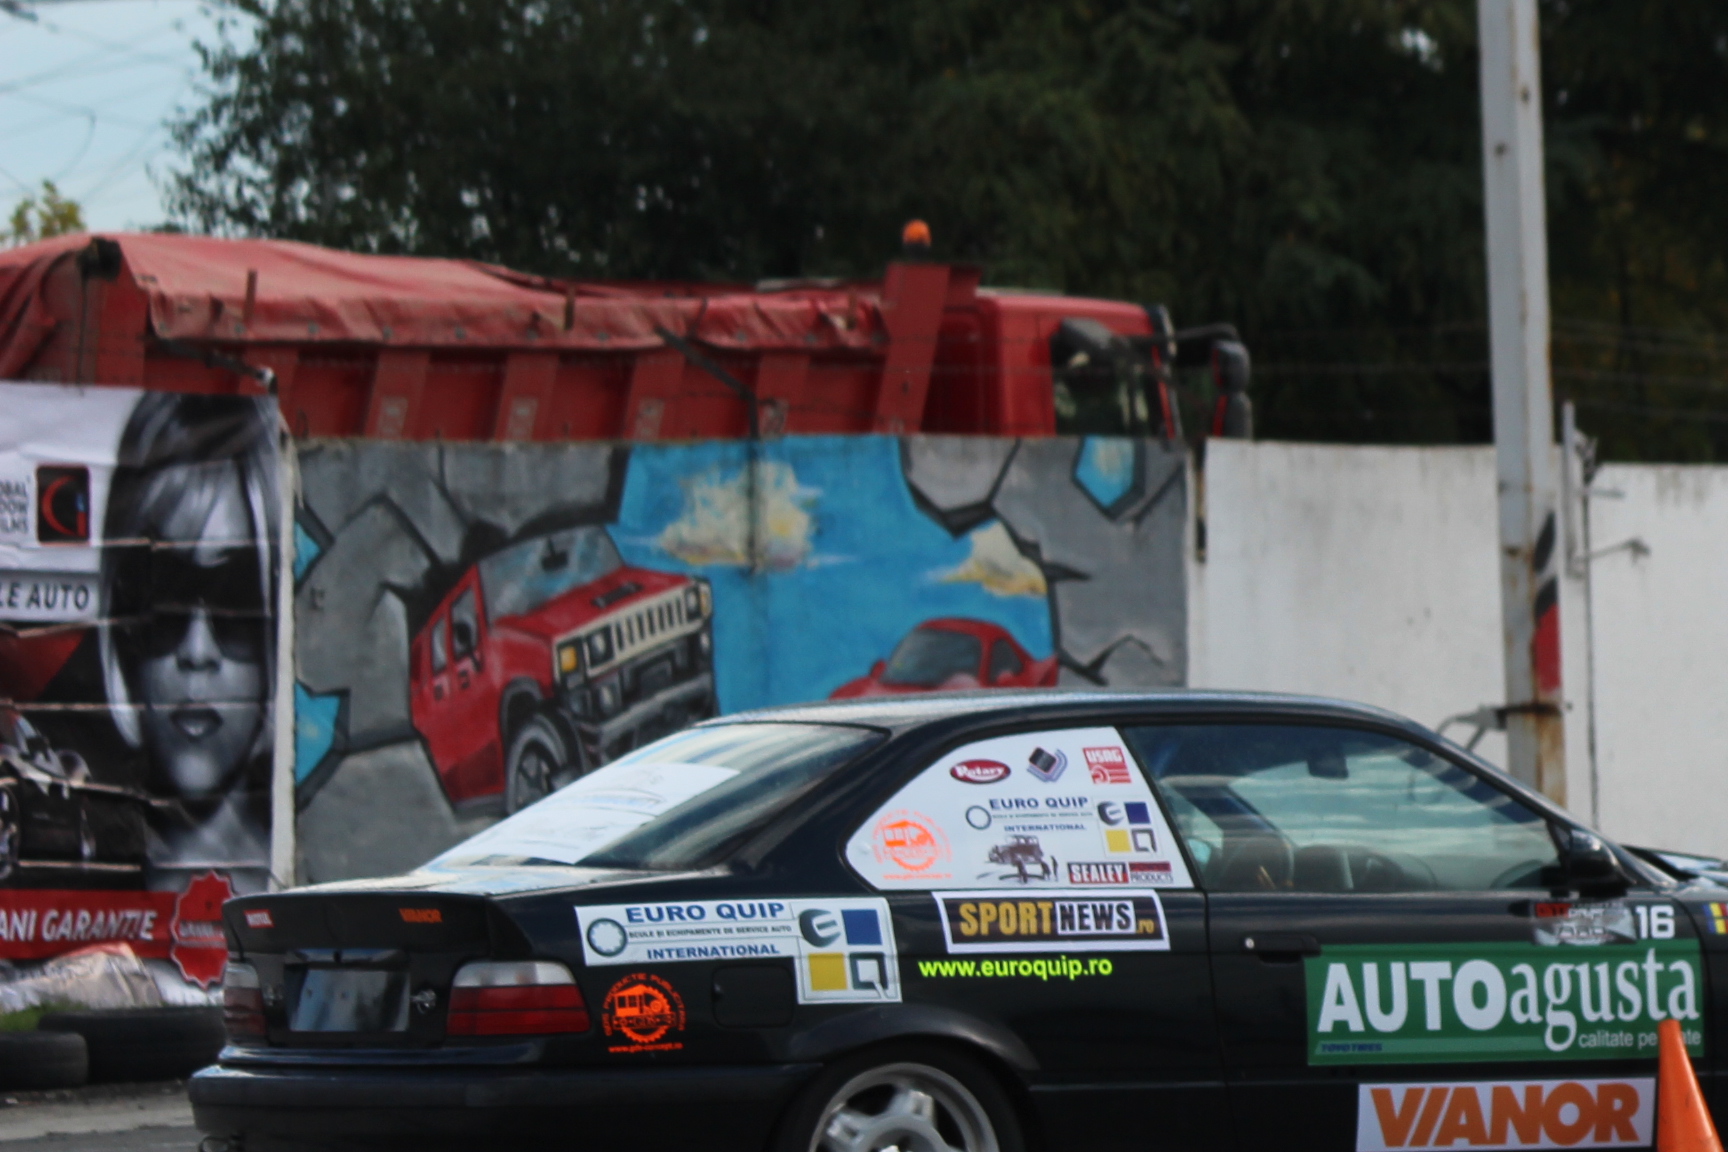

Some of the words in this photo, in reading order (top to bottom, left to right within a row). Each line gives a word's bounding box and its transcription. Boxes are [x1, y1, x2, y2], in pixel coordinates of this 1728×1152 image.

[26, 585, 90, 610] AUTO
[954, 764, 1005, 778] Rotary
[989, 798, 1039, 810] EURO
[1045, 796, 1089, 810] QUIP
[1004, 824, 1087, 832] INTERNATIONAL
[1070, 865, 1124, 883] SEALEY
[625, 904, 706, 923] EURO
[716, 902, 784, 921] QUIP
[1635, 905, 1676, 940] 16
[647, 944, 780, 960] INTERNATIONAL
[918, 956, 1113, 980] www.euroquip.ro
[1578, 1029, 1634, 1048] calitate
[1637, 1032, 1657, 1049] pe
[1370, 1082, 1641, 1148] VIANOR
